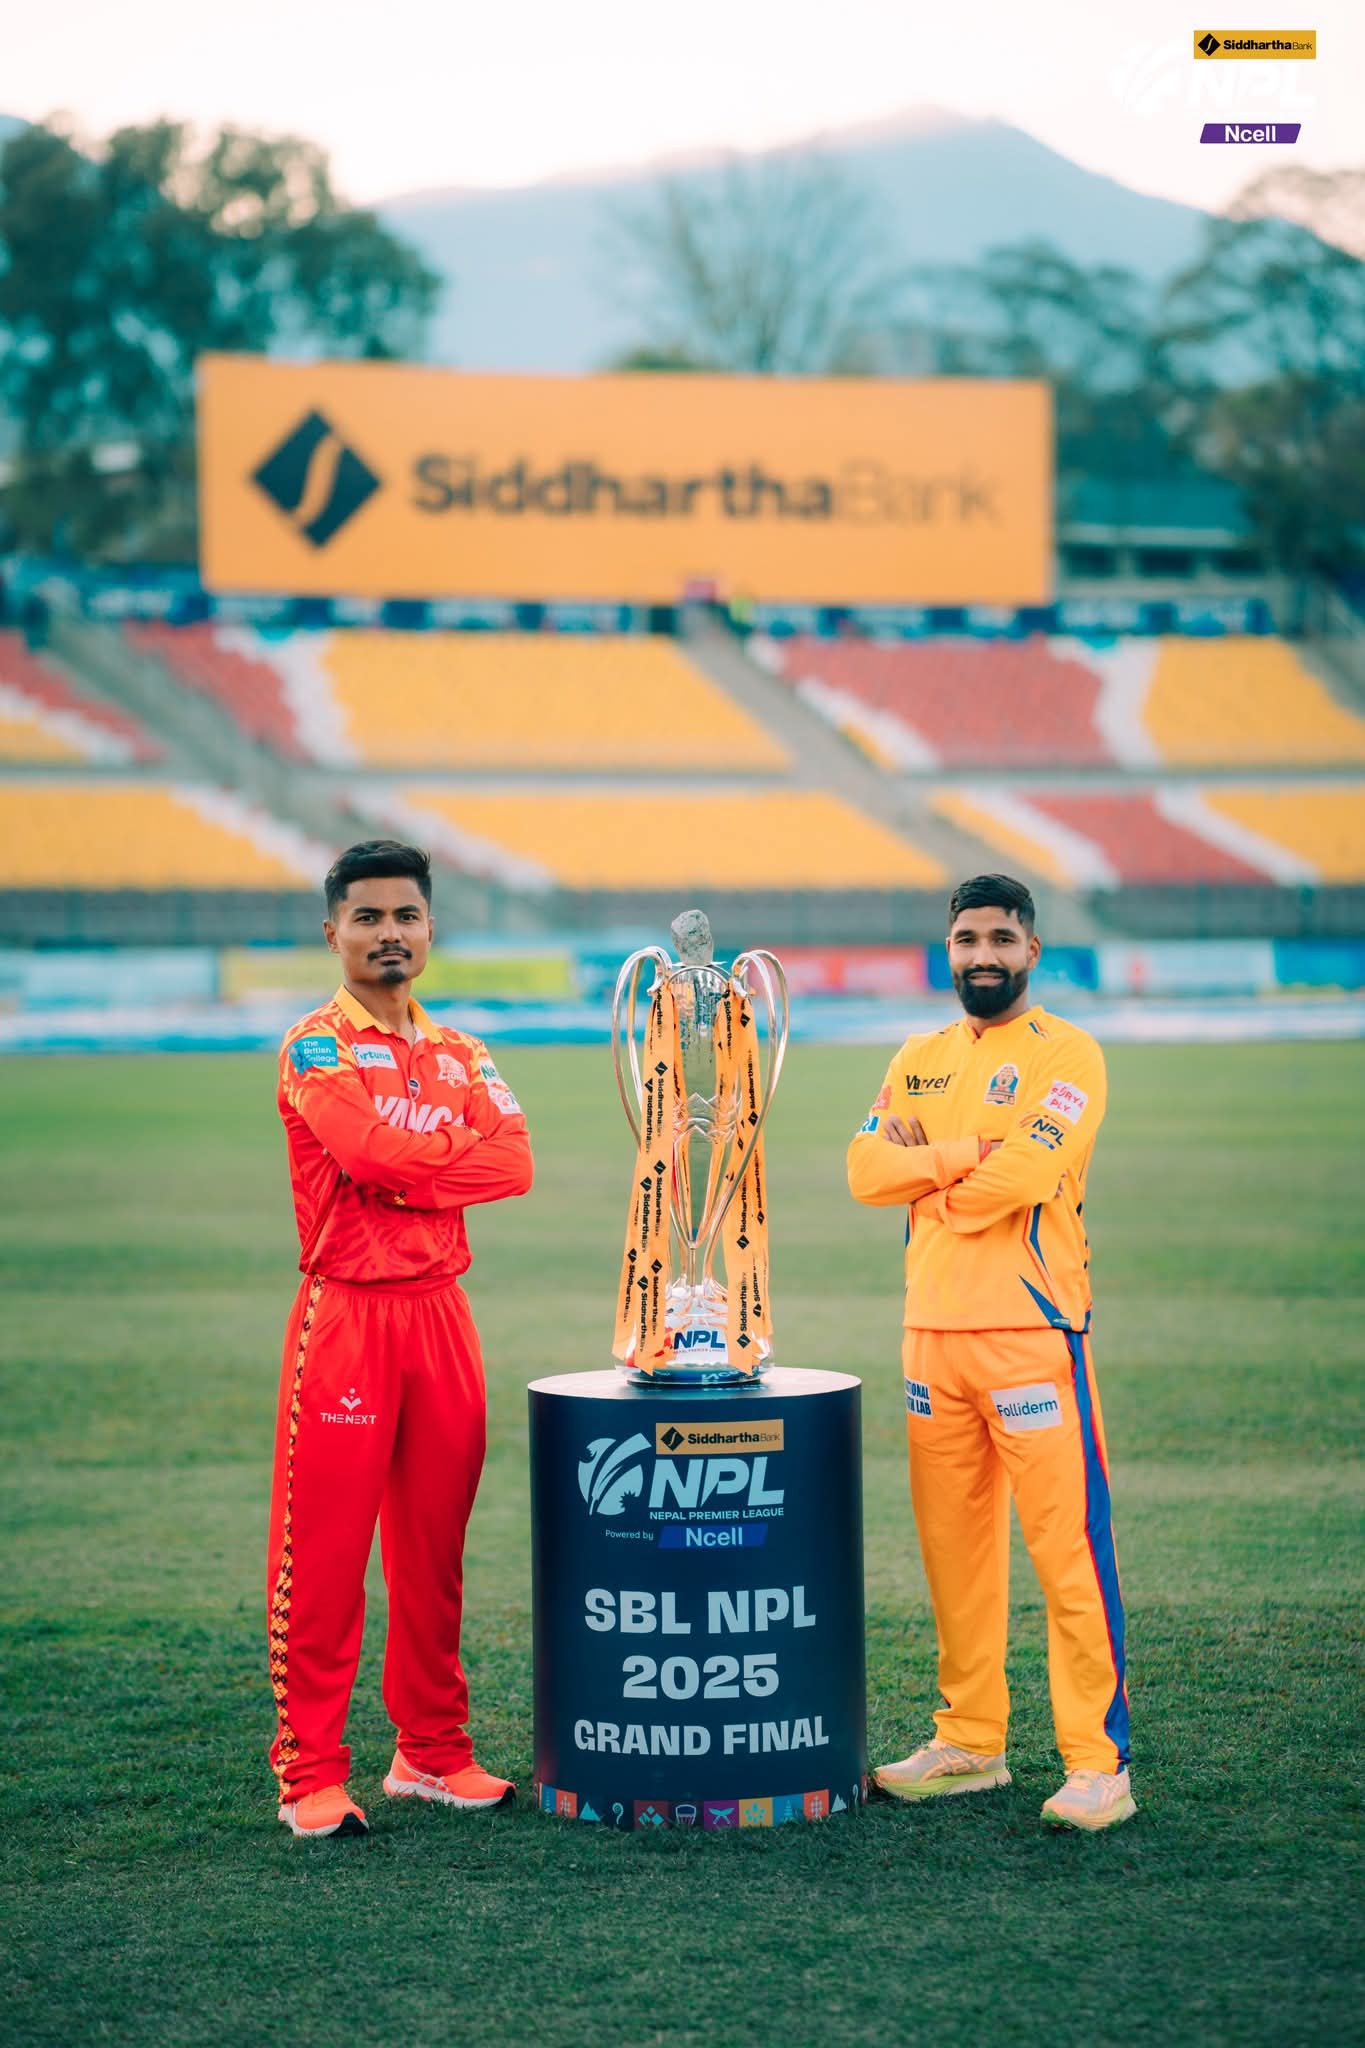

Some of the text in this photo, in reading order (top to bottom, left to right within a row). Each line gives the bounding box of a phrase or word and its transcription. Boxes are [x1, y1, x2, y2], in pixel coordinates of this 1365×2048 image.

[302, 1040, 318, 1048] The
[1049, 1098, 1071, 1111] PLY
[1031, 1118, 1064, 1147] NPL
[674, 1330, 726, 1350] NPL
[916, 1399, 932, 1416] LAB
[996, 1400, 1059, 1417] Folliderm
[648, 1456, 785, 1508] NPL
[650, 1507, 784, 1520] NEPAL PREMIER LEAGUE
[605, 1529, 654, 1541] Powered by
[686, 1527, 743, 1547] Ncell
[584, 1585, 817, 1635] SBL NPL
[622, 1652, 780, 1700] 2025
[574, 1715, 829, 1756] GRAND FINAL
